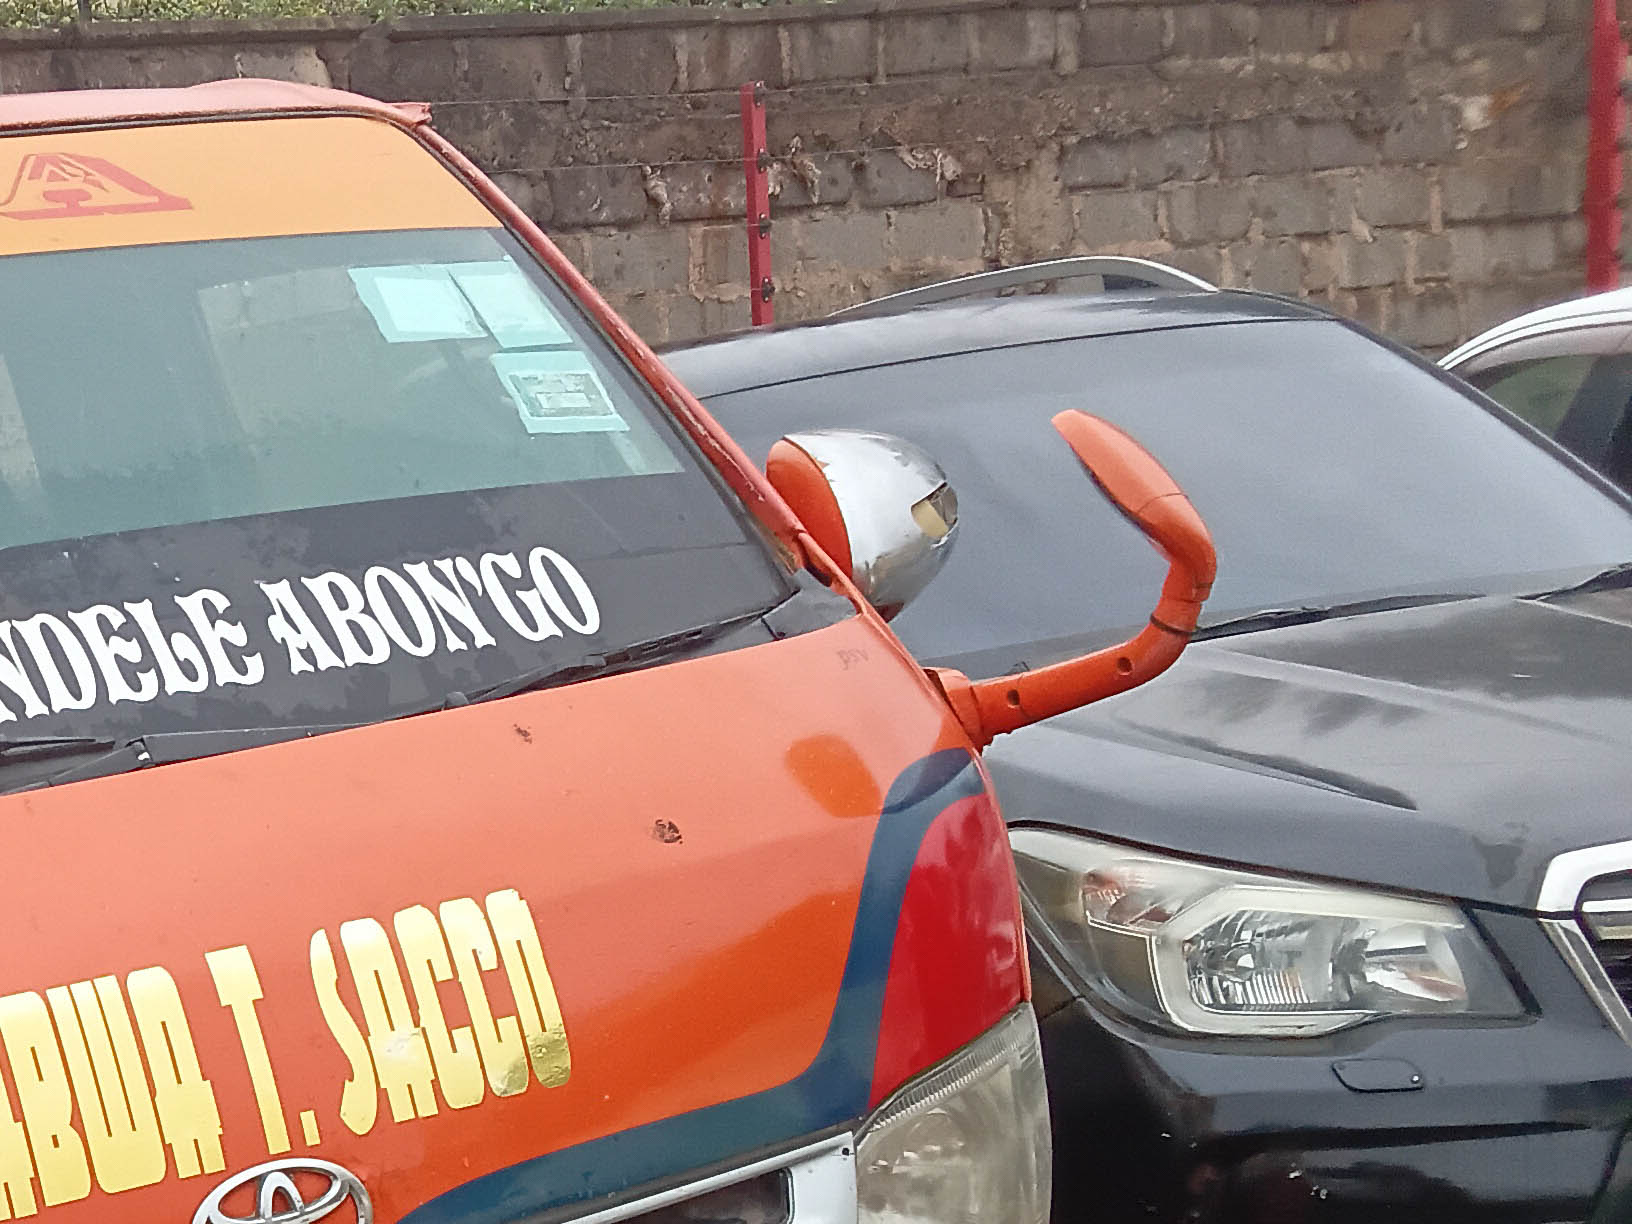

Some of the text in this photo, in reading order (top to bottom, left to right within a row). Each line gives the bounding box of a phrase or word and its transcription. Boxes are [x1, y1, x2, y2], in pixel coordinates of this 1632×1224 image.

[266, 544, 601, 677] ABON'GO
[205, 945, 320, 1154] T.
[310, 888, 572, 1135] SACCO
